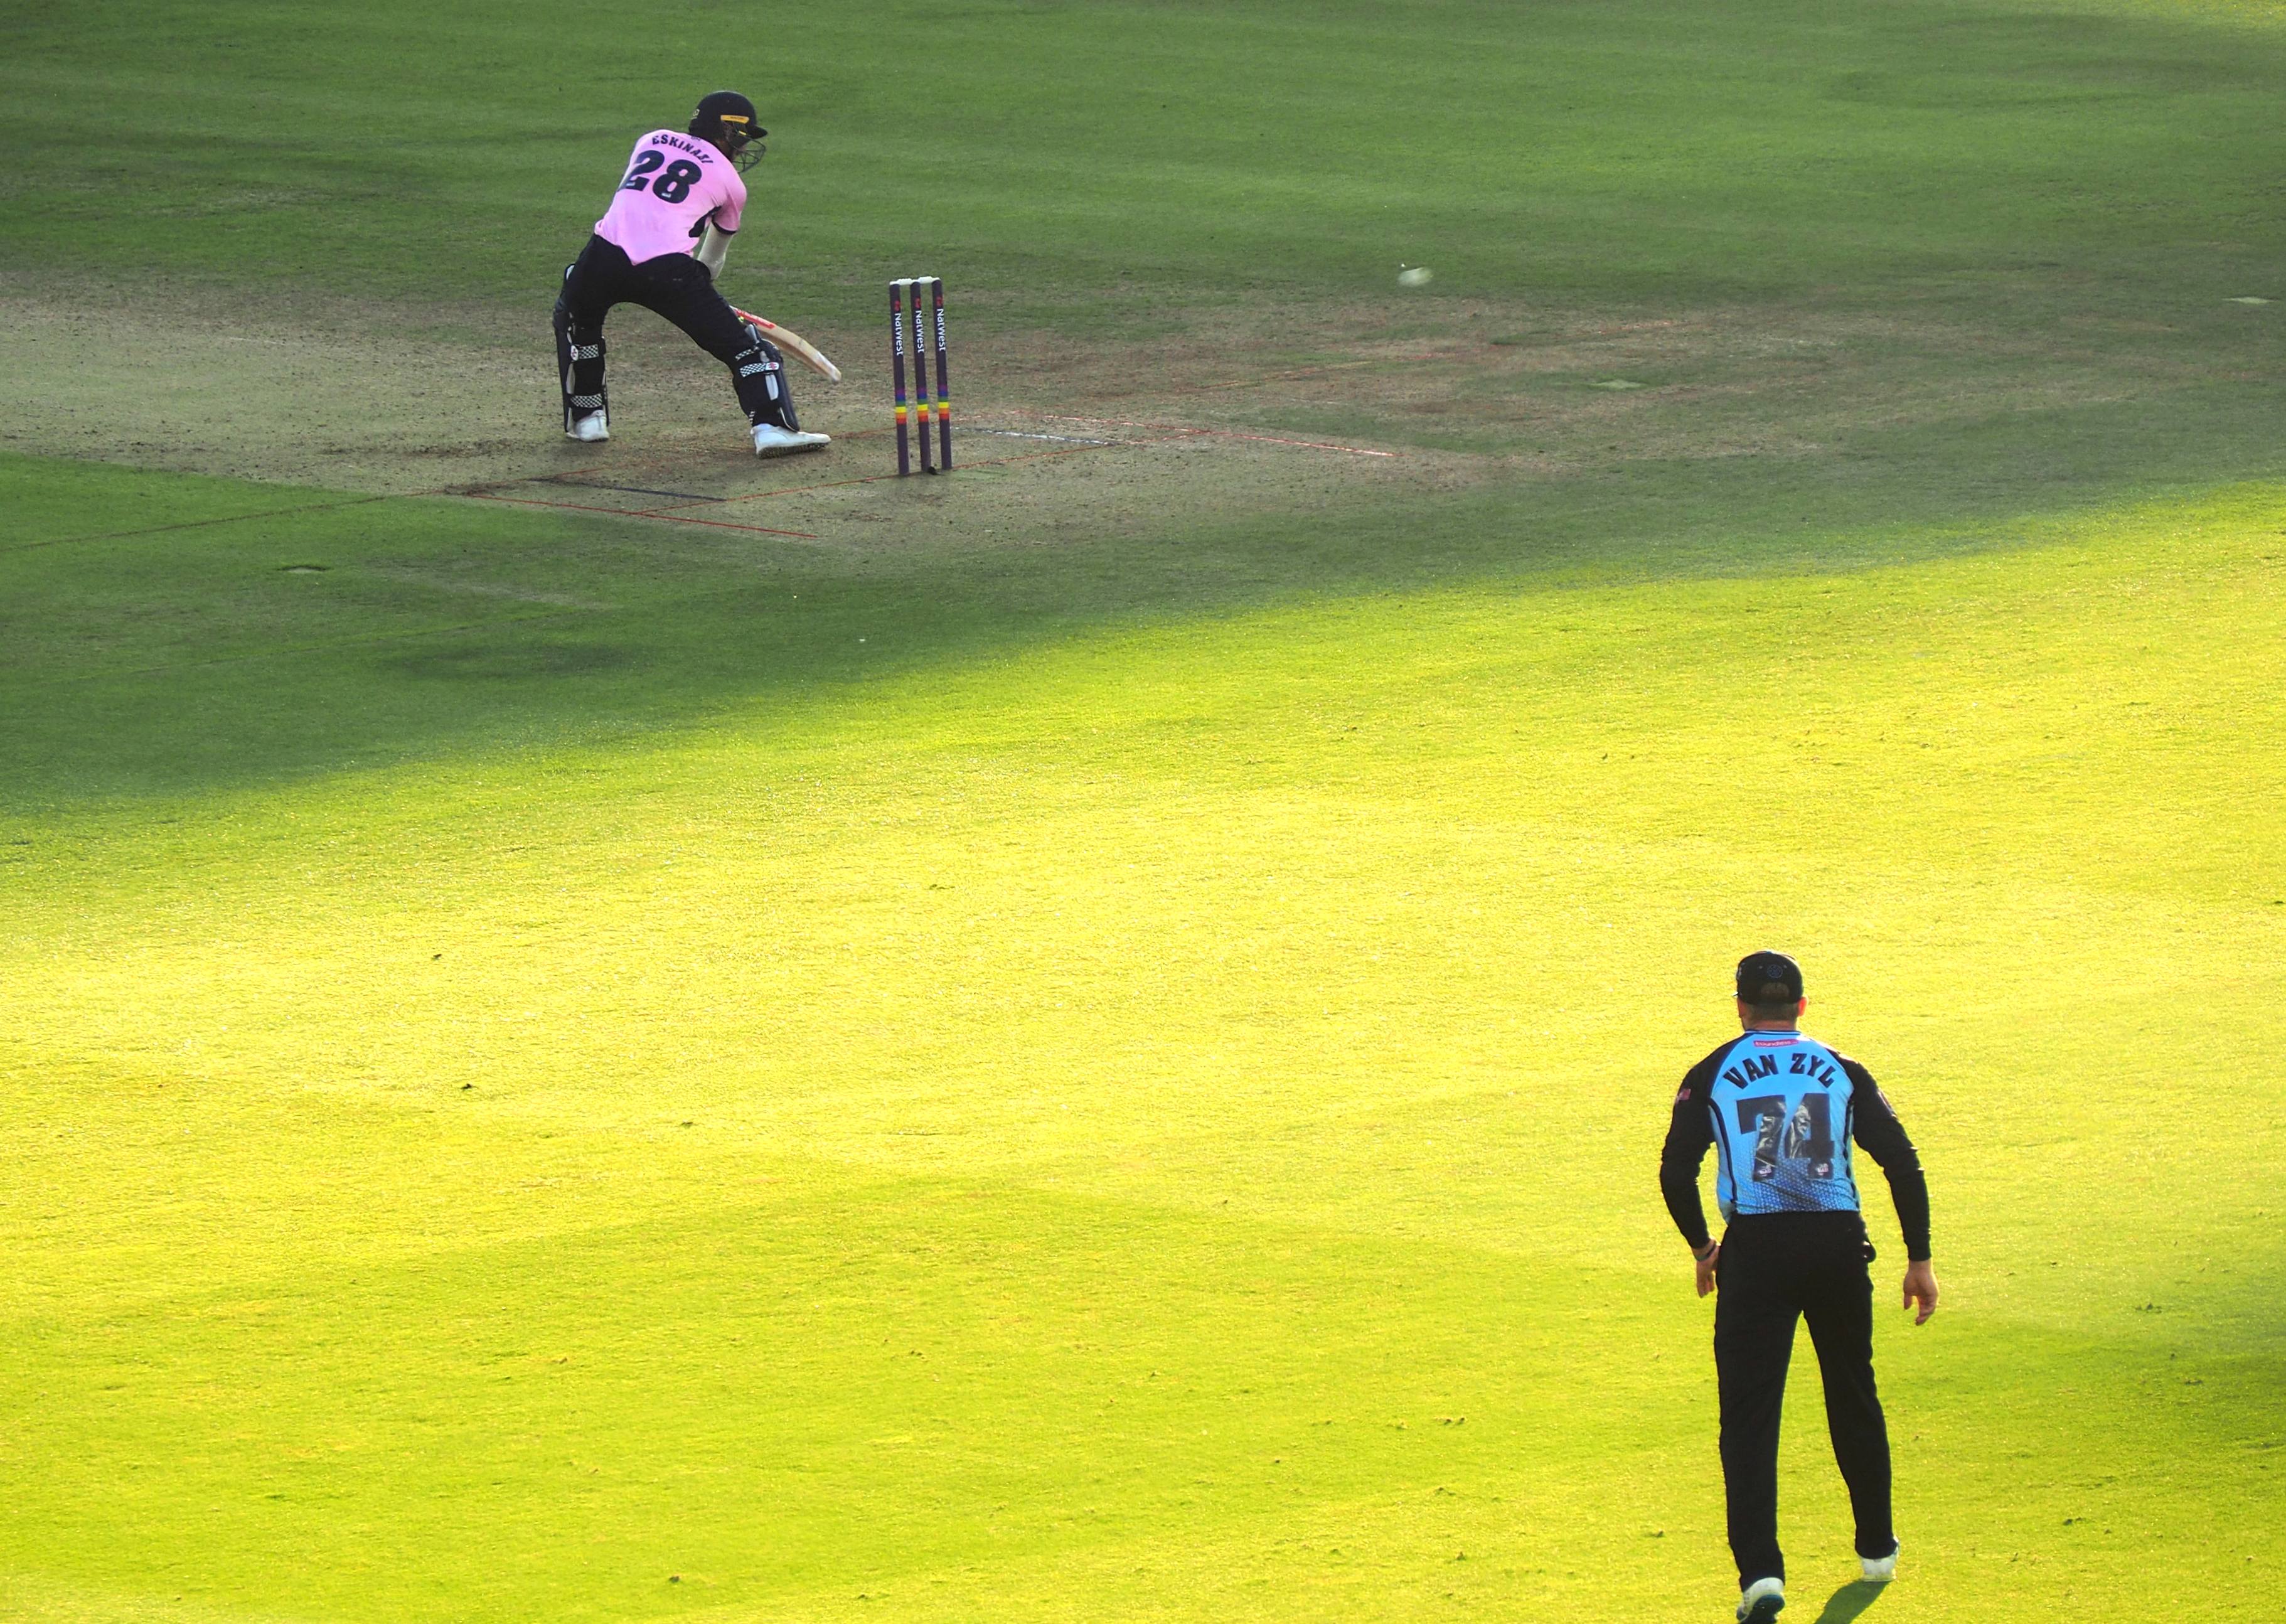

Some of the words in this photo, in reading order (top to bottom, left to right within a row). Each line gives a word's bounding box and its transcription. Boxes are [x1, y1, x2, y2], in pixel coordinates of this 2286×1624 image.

[617, 150, 702, 203] 28
[895, 313, 903, 355] NatWest
[916, 310, 924, 353] NatWest
[937, 309, 946, 351] NatWest
[1723, 1054, 1778, 1089] VAN
[1790, 1053, 1836, 1088] ZYL
[1736, 1092, 1834, 1182] 74
